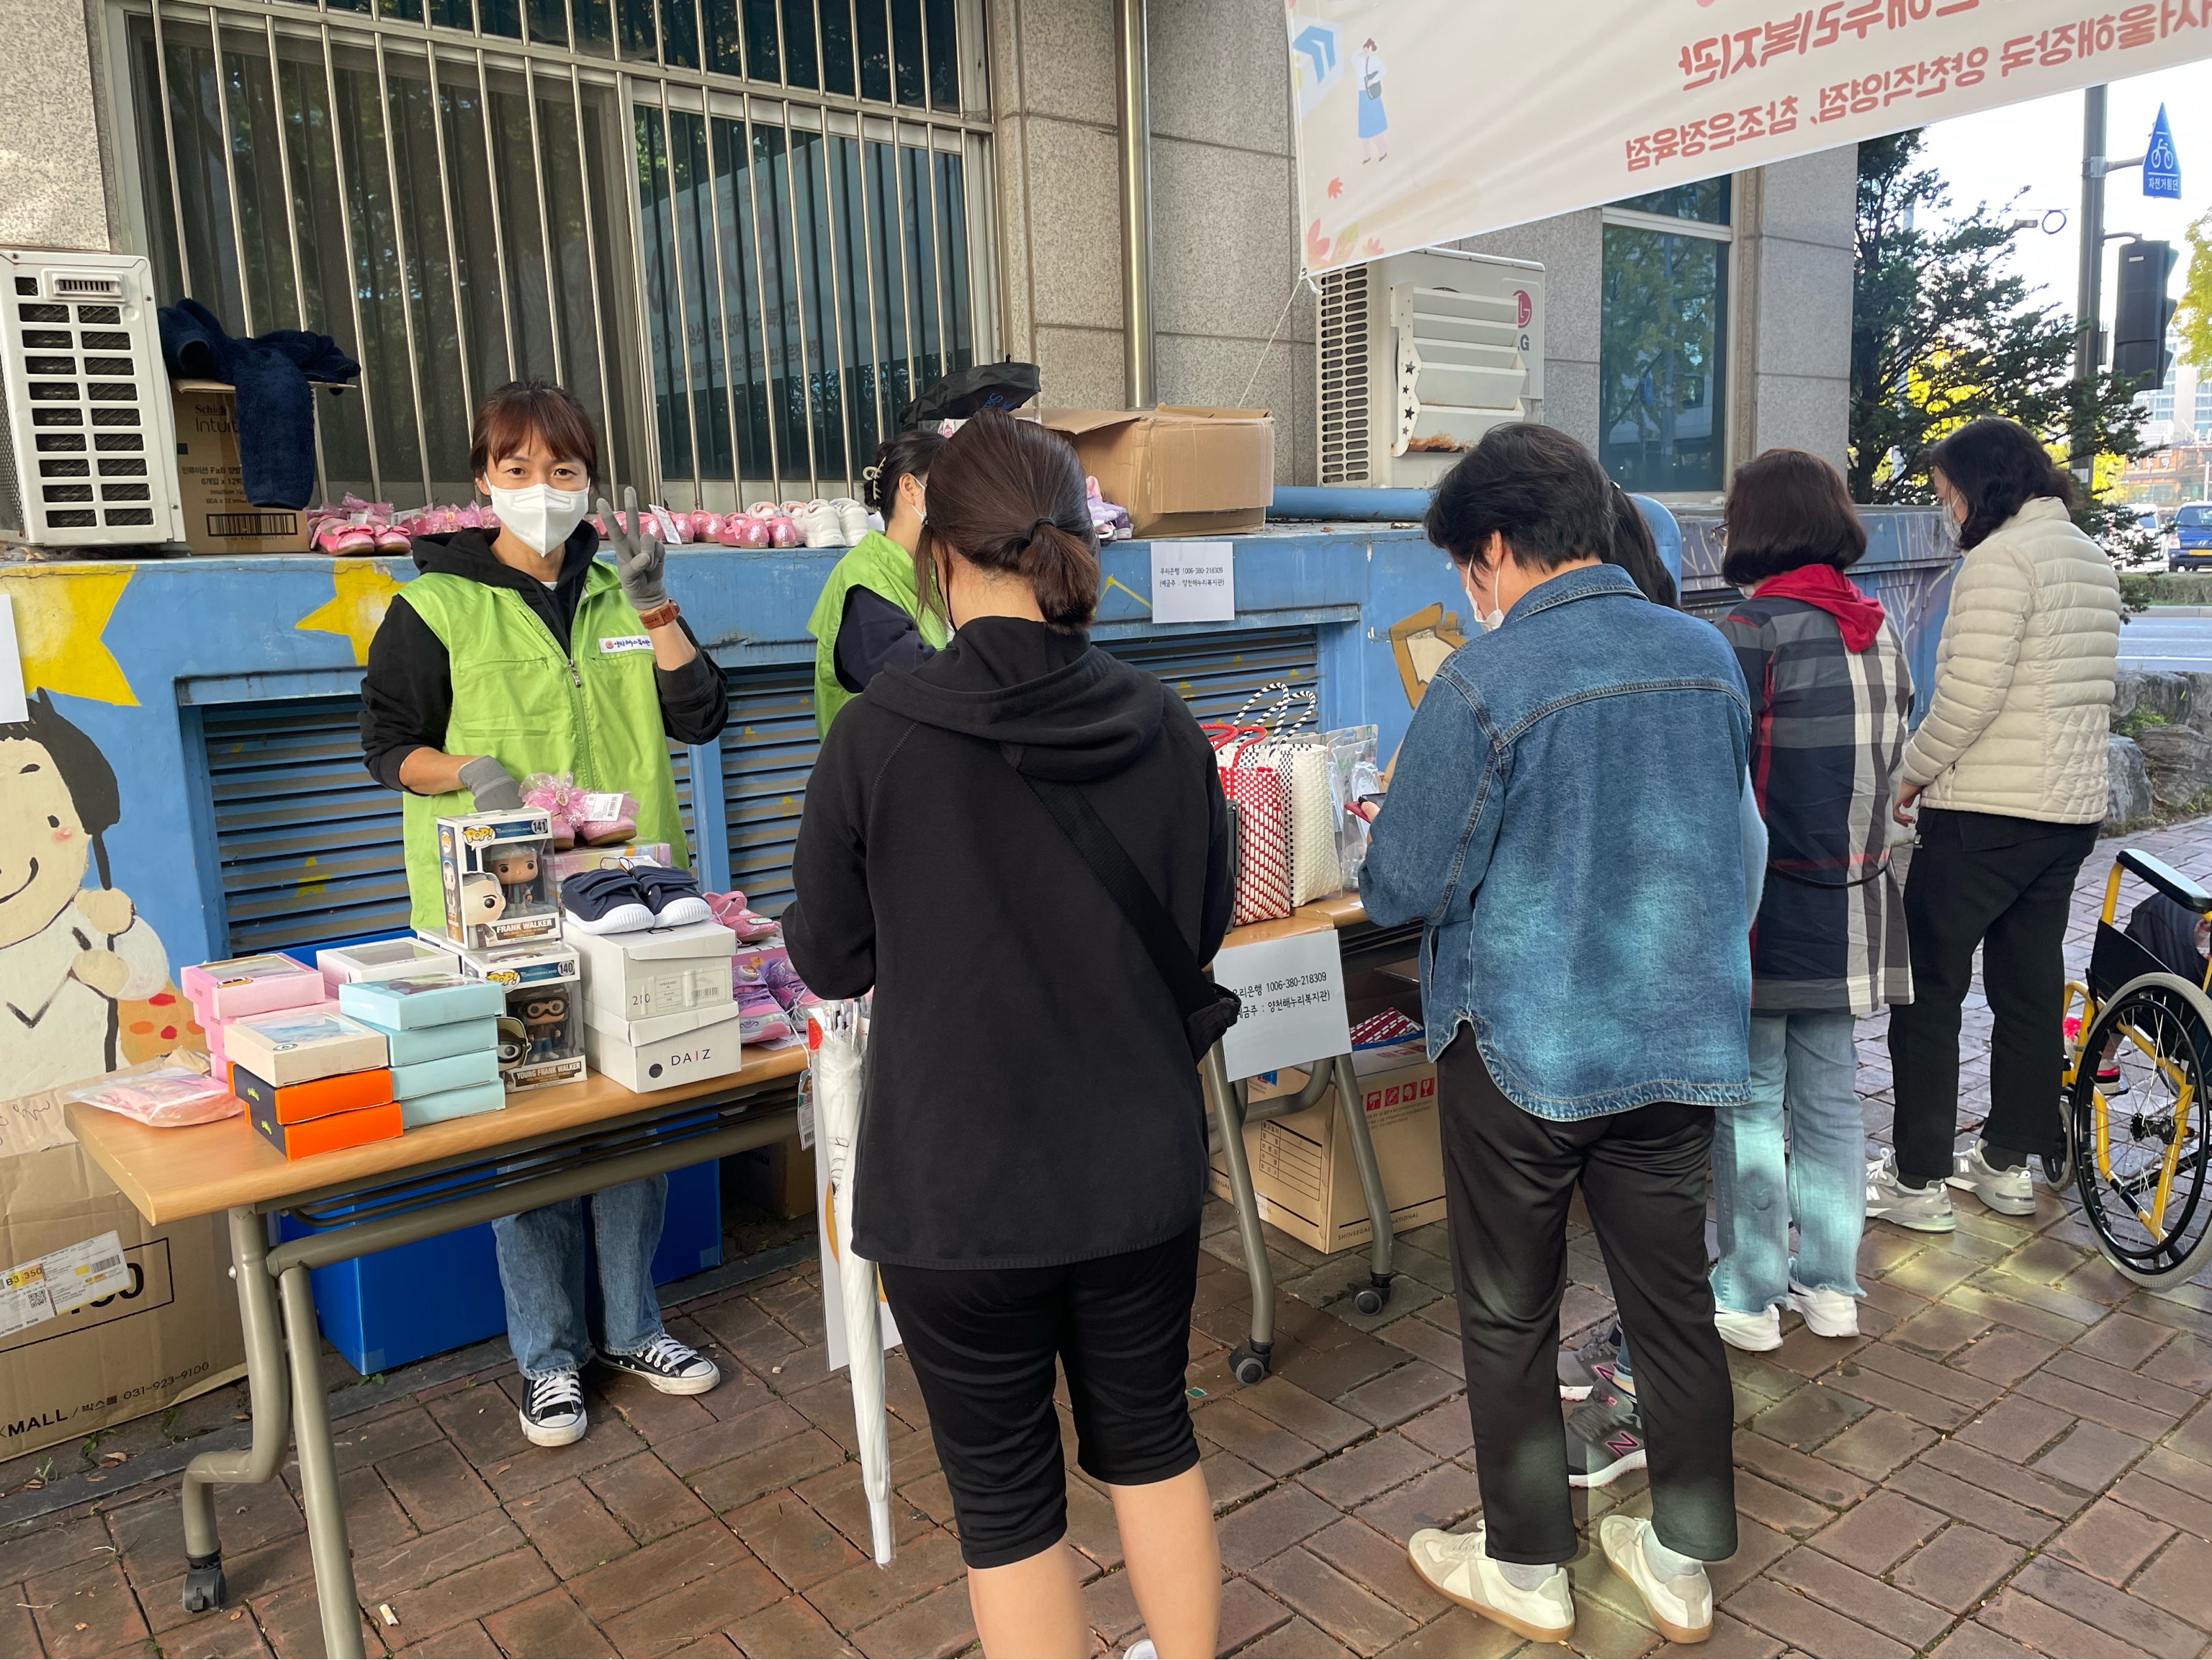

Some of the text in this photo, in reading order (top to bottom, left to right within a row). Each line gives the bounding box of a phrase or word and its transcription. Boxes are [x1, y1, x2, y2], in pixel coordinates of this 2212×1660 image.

[2149, 177, 2178, 191] 자전거횡단
[462, 827, 494, 843] POP!
[532, 820, 548, 835] 141
[497, 923, 522, 933] FRANK
[523, 918, 552, 930] WALKER
[559, 962, 573, 974] 140
[1266, 972, 1327, 992] 1006-380-218309
[632, 993, 651, 1005] 210
[1268, 990, 1331, 1013] 양천해누리복지관)
[671, 1049, 711, 1066] DAIZ
[516, 1067, 536, 1080] YOUNG
[537, 1064, 557, 1077] FRANK
[557, 1061, 581, 1074] WALKER
[1338, 1226, 1371, 1241] SHINSEGAE
[6, 1267, 42, 1286] B3 350
[123, 1361, 210, 1401] 031-923-9100
